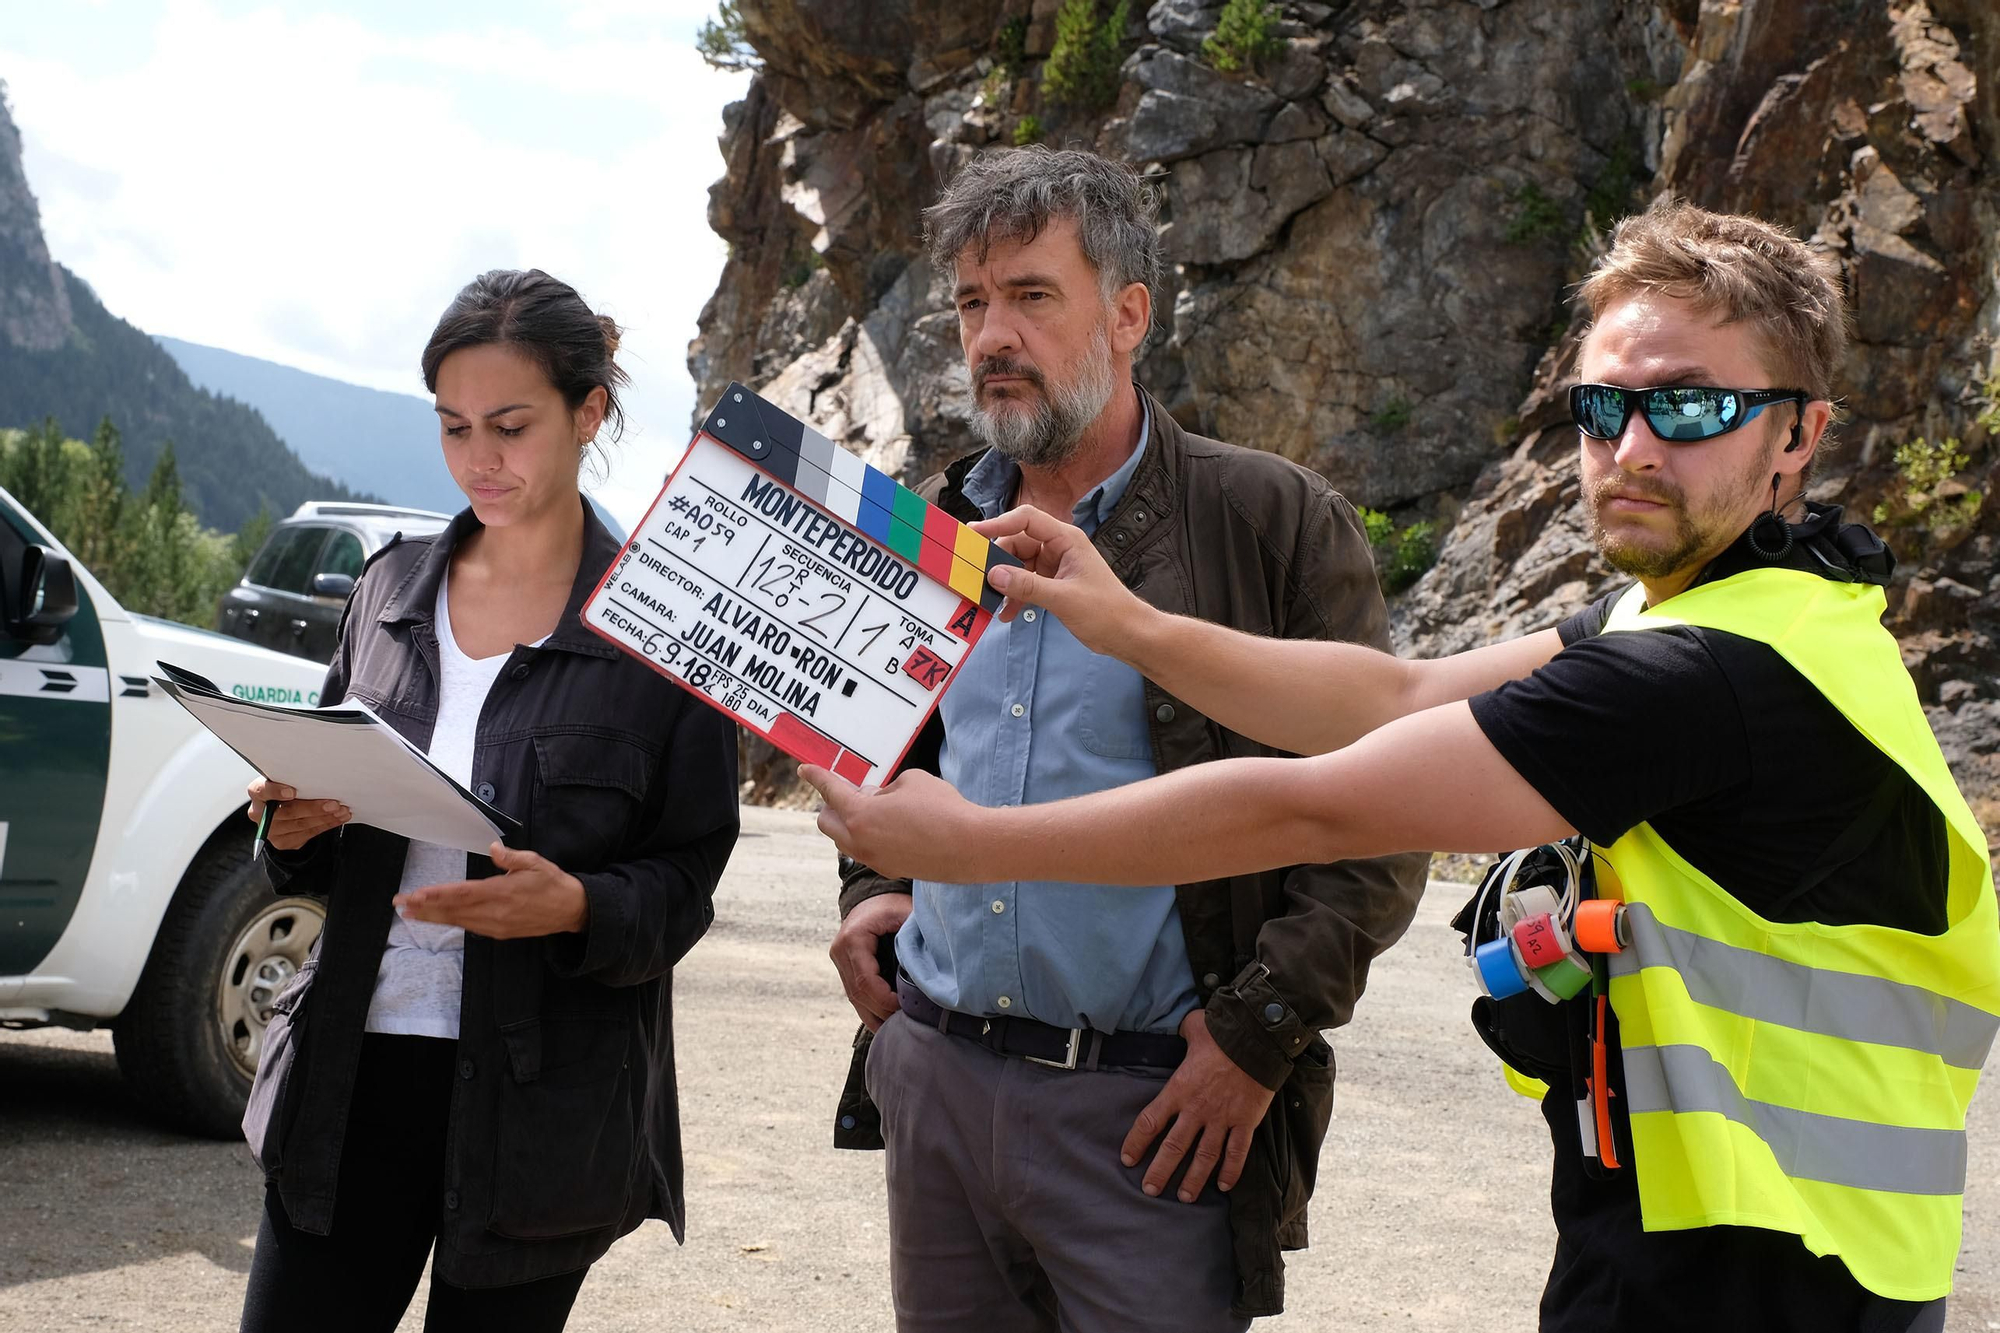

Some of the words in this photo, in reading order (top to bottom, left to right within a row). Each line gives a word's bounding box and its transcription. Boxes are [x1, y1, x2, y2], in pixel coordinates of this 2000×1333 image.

[704, 495, 747, 527] ROLLO
[664, 521, 690, 541] CAP
[694, 537, 706, 552] 1
[740, 473, 919, 600] MONTEPERDIDO
[604, 554, 631, 590] WELAB
[782, 544, 852, 594] SECUENCIA
[601, 608, 648, 643] FECHA:
[638, 553, 705, 600] DIRECTOR:
[702, 592, 791, 655] ALVARO
[795, 647, 843, 690] RON
[899, 616, 934, 645] TOMA
[951, 606, 978, 638] A
[620, 582, 677, 623] CAMARA:
[681, 620, 742, 668] JUAN
[741, 654, 821, 718] MOLINA
[862, 623, 890, 656] 1
[884, 657, 898, 674] B
[911, 650, 945, 687] 7K
[233, 684, 301, 704] GUARDIA
[711, 669, 733, 689] FPS
[732, 684, 750, 700] 25
[721, 692, 742, 712] 180
